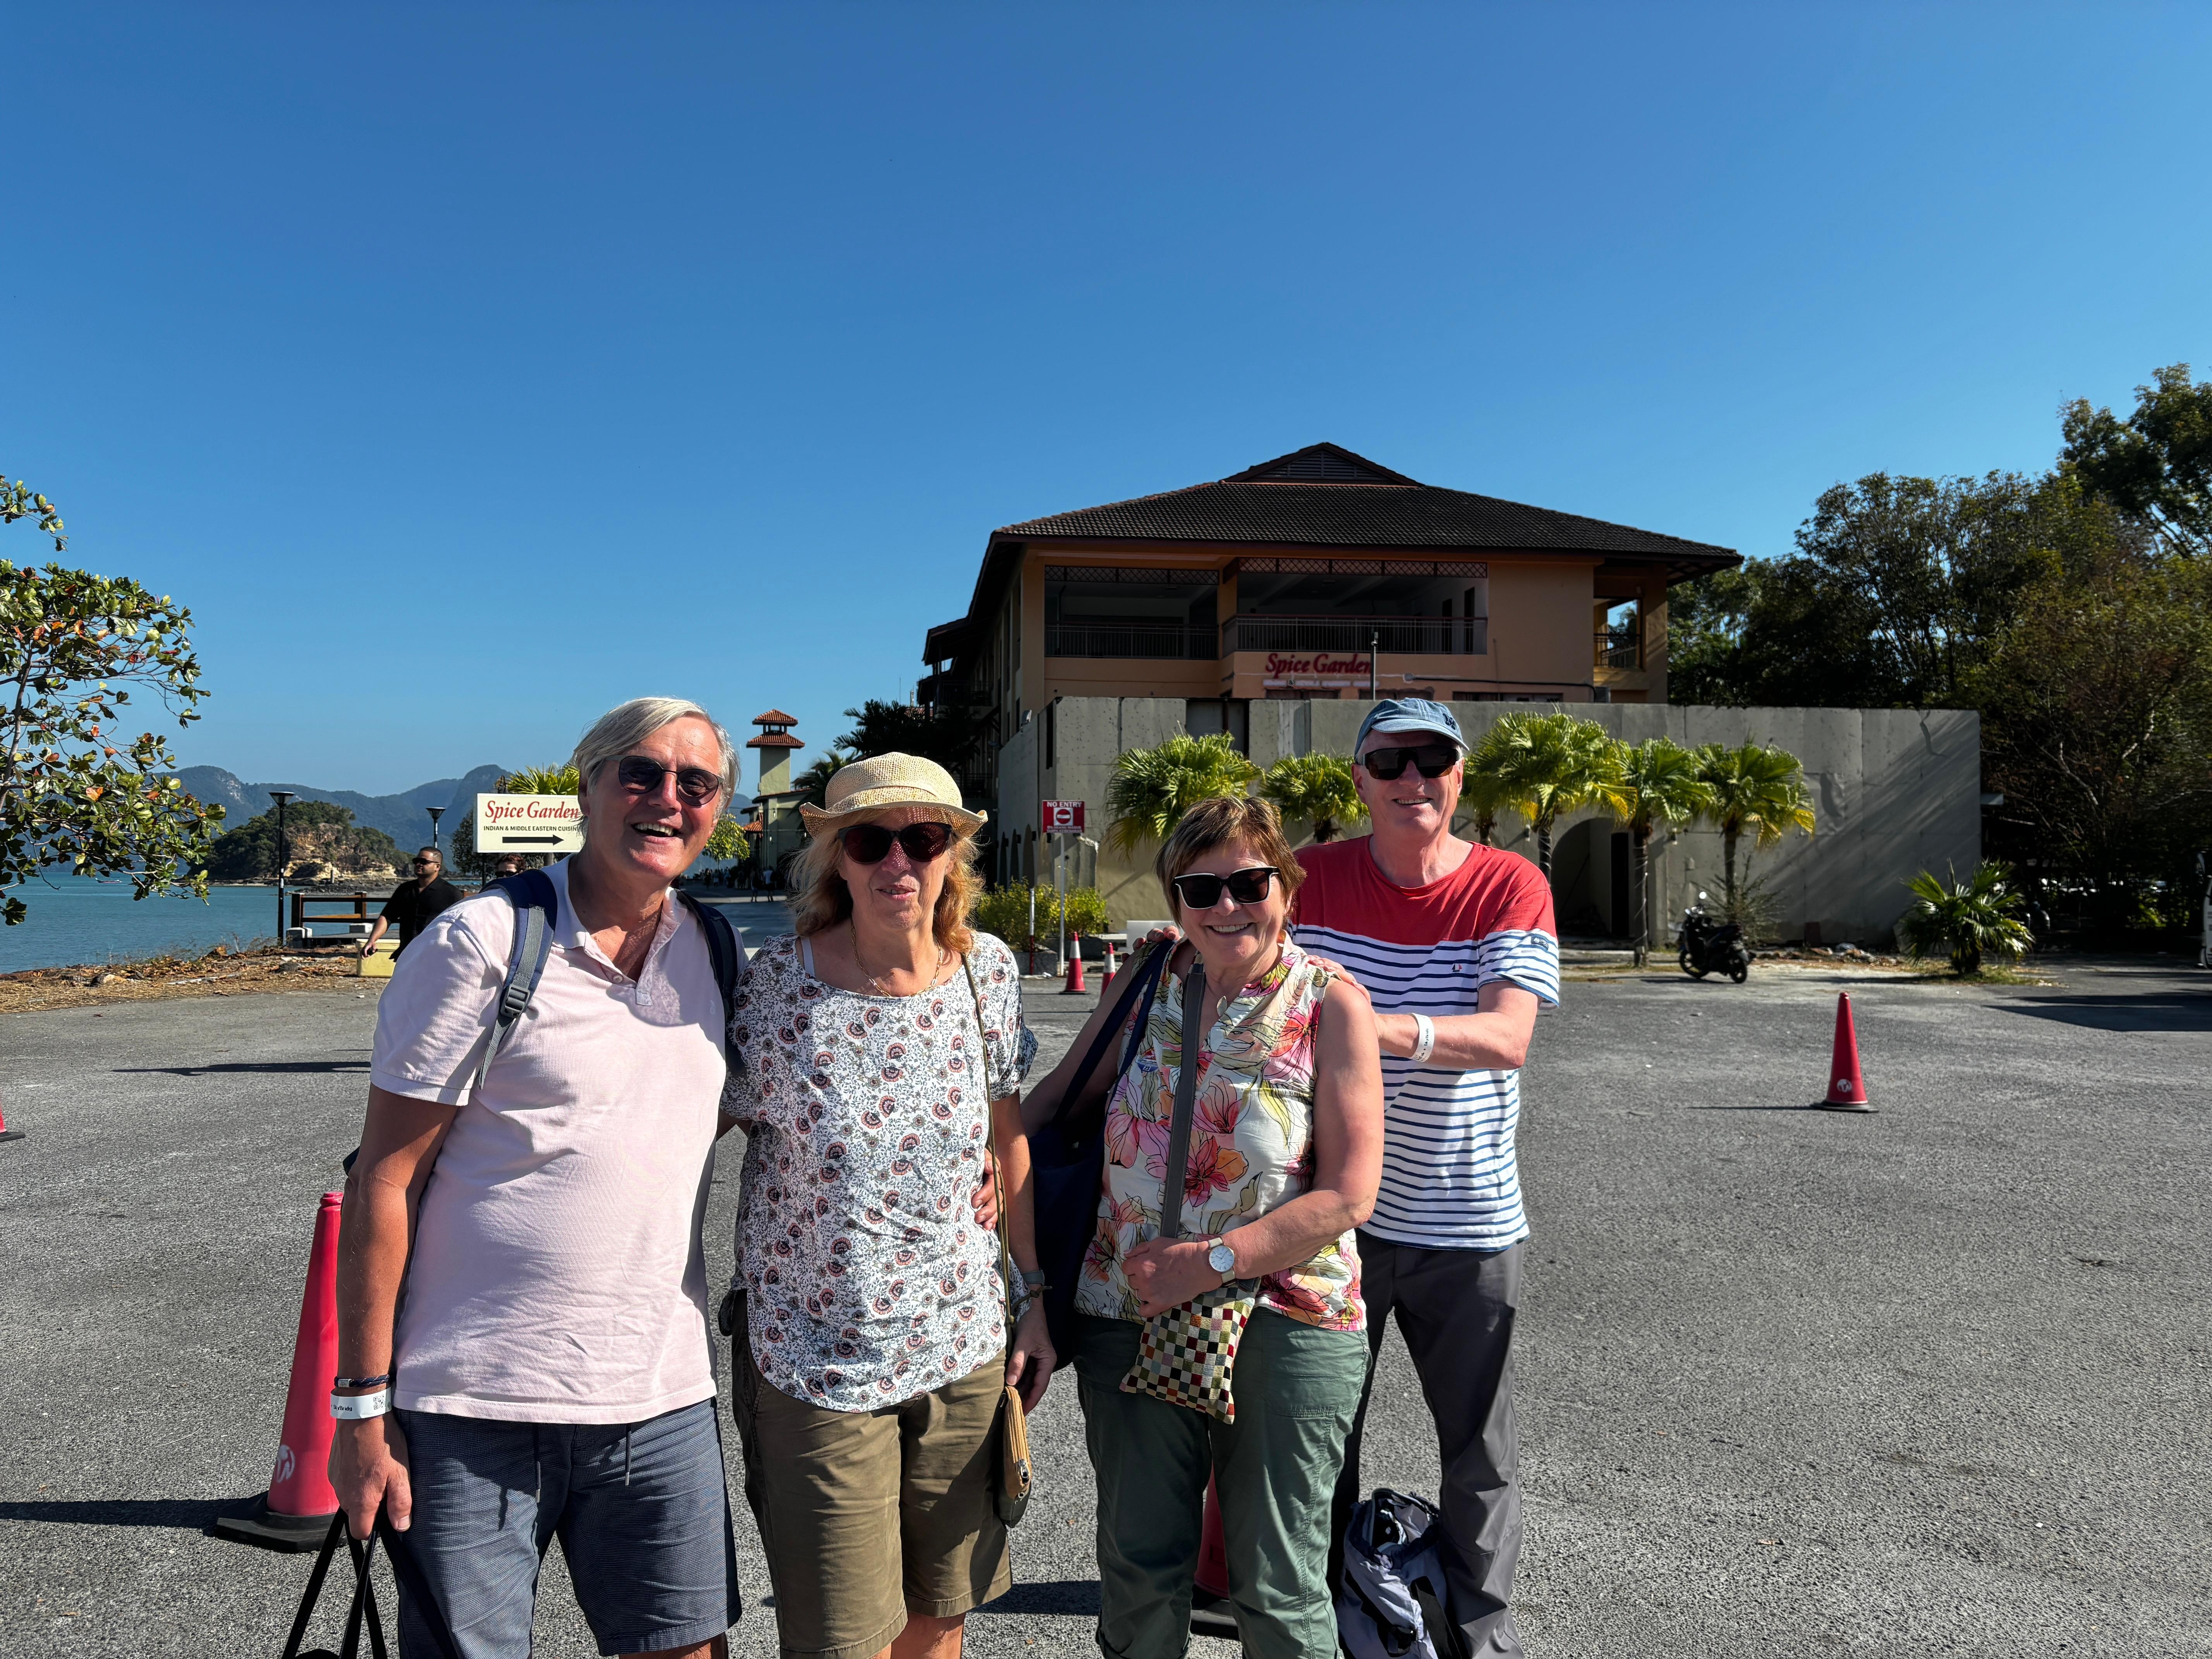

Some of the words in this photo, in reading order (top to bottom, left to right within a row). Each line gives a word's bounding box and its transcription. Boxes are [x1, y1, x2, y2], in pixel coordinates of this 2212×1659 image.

[1266, 653, 1310, 678] Spice
[1314, 653, 1371, 673] Garden
[485, 800, 524, 823] Spice
[527, 801, 579, 818] Garden
